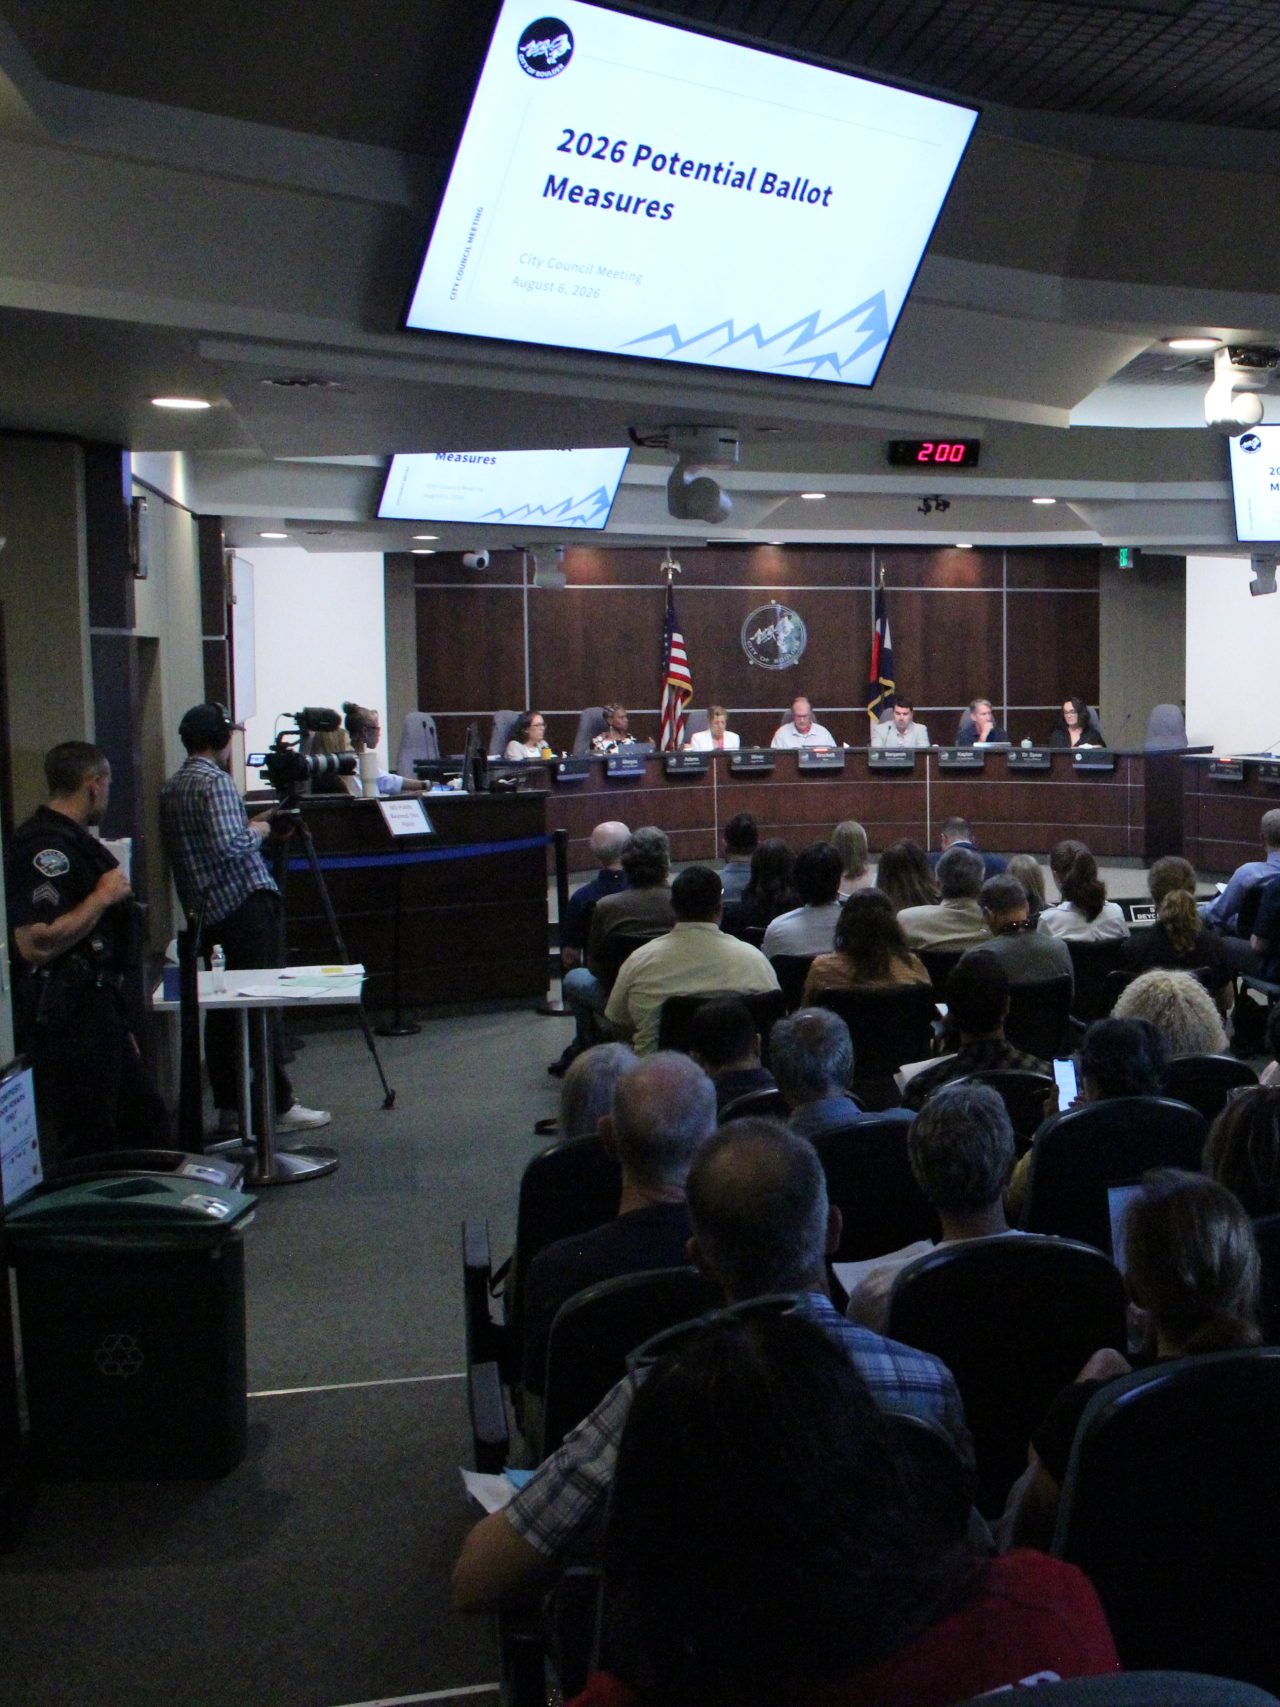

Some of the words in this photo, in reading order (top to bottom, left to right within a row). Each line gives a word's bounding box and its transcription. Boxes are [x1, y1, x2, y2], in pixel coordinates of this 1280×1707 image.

[556, 128, 628, 163] 2026
[632, 143, 757, 191] Potential
[759, 171, 833, 207] Ballot
[542, 174, 675, 220] Measures
[449, 282, 460, 300] CITY
[456, 245, 471, 281] COUNCIL
[467, 206, 483, 243] MEETING
[519, 253, 545, 269] City
[547, 257, 594, 275] Council
[597, 265, 643, 286] Meeting
[511, 276, 554, 292] August
[558, 282, 567, 296] 6,
[571, 284, 600, 299] 2026
[435, 452, 496, 465] Measures
